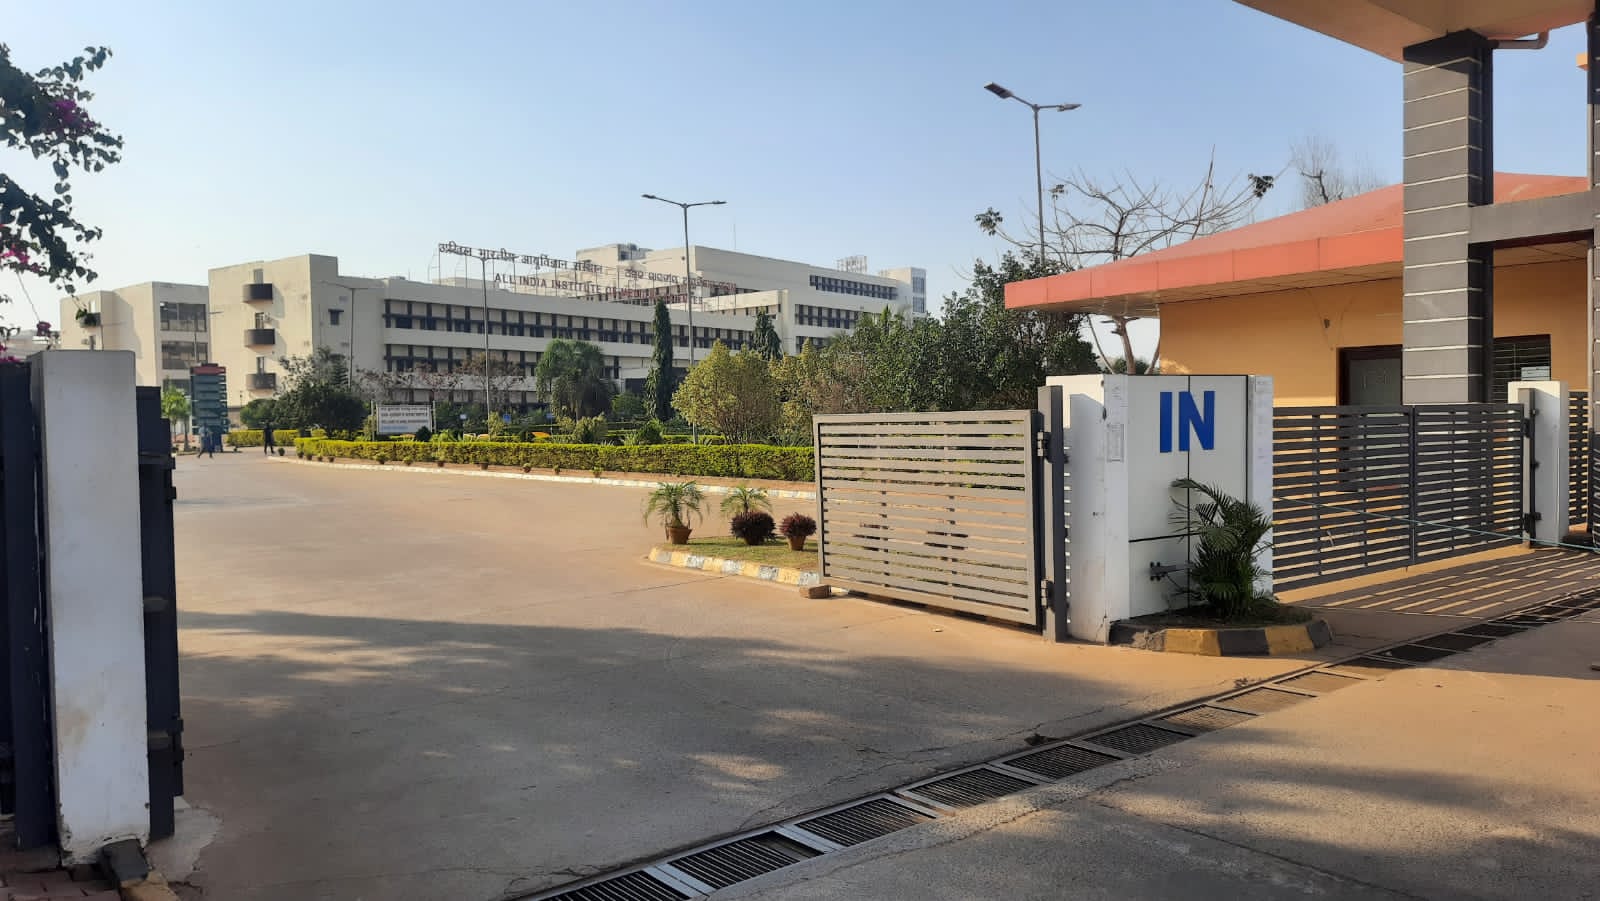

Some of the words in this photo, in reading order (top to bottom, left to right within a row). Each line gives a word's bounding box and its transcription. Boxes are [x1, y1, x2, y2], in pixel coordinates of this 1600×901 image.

[495, 273, 516, 285] ALL
[519, 276, 547, 288] INDIA
[551, 280, 601, 294] INSTITUTE
[1159, 390, 1215, 453] IN
